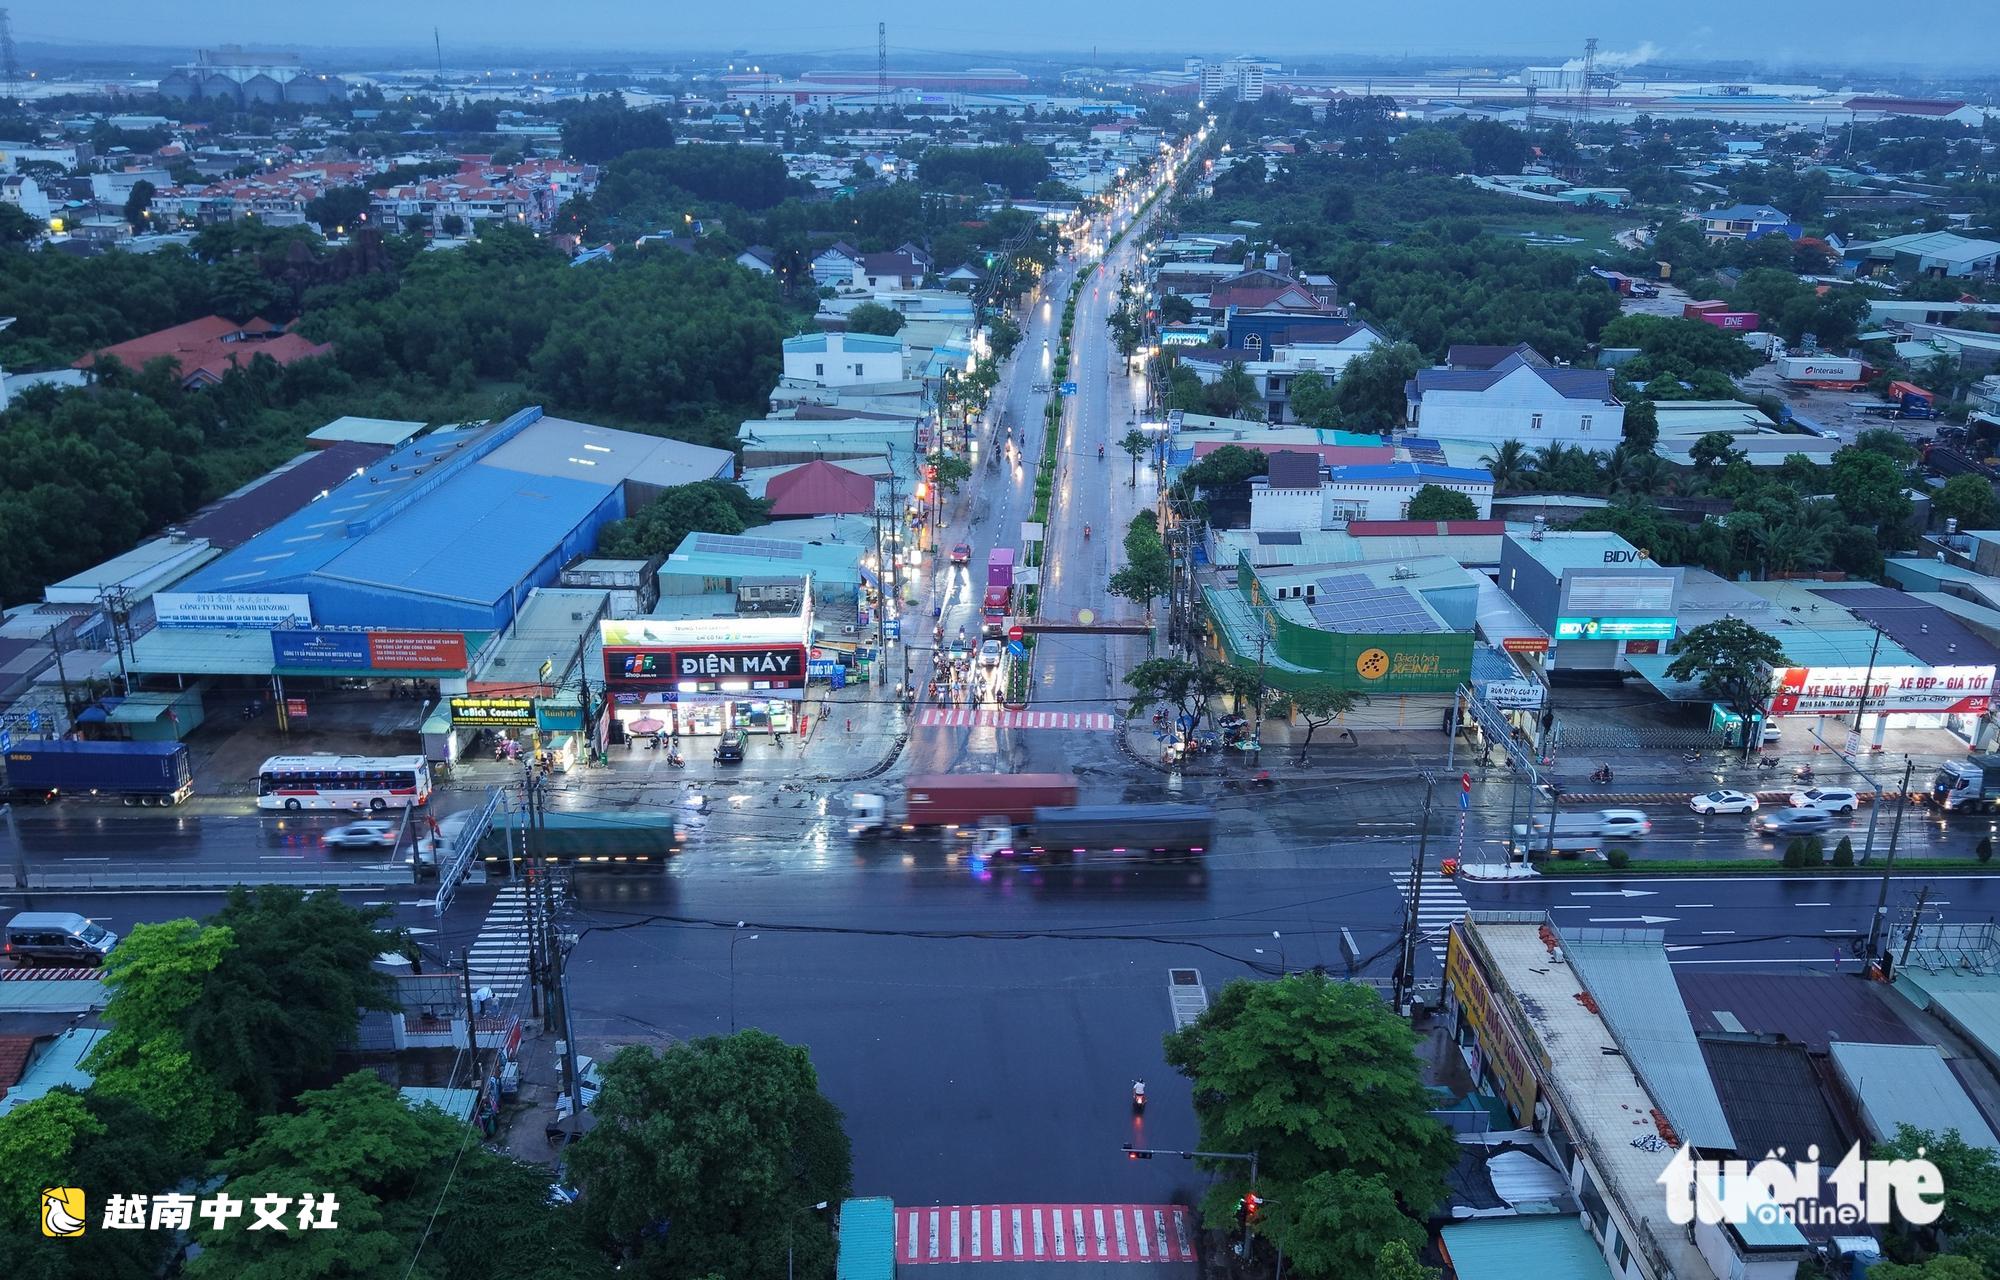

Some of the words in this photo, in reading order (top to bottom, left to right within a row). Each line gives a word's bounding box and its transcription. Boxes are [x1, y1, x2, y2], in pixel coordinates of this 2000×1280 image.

[1724, 317, 1743, 326] ONE
[1813, 366, 1844, 375] Interasia
[1603, 551, 1638, 563] BIDV
[1560, 623, 1587, 634] BIDV
[682, 653, 735, 677] ĐIỆN
[743, 652, 791, 673] MÁY
[1899, 677, 1914, 689] XE
[1916, 677, 1937, 692] ĐẸP
[1946, 674, 1965, 689] GIÁ
[1968, 673, 1988, 690] TỐT
[1807, 685, 1820, 697] XE
[1872, 681, 1890, 697] MỸ
[1782, 698, 1789, 706] 2
[489, 708, 529, 717] Cosmetic
